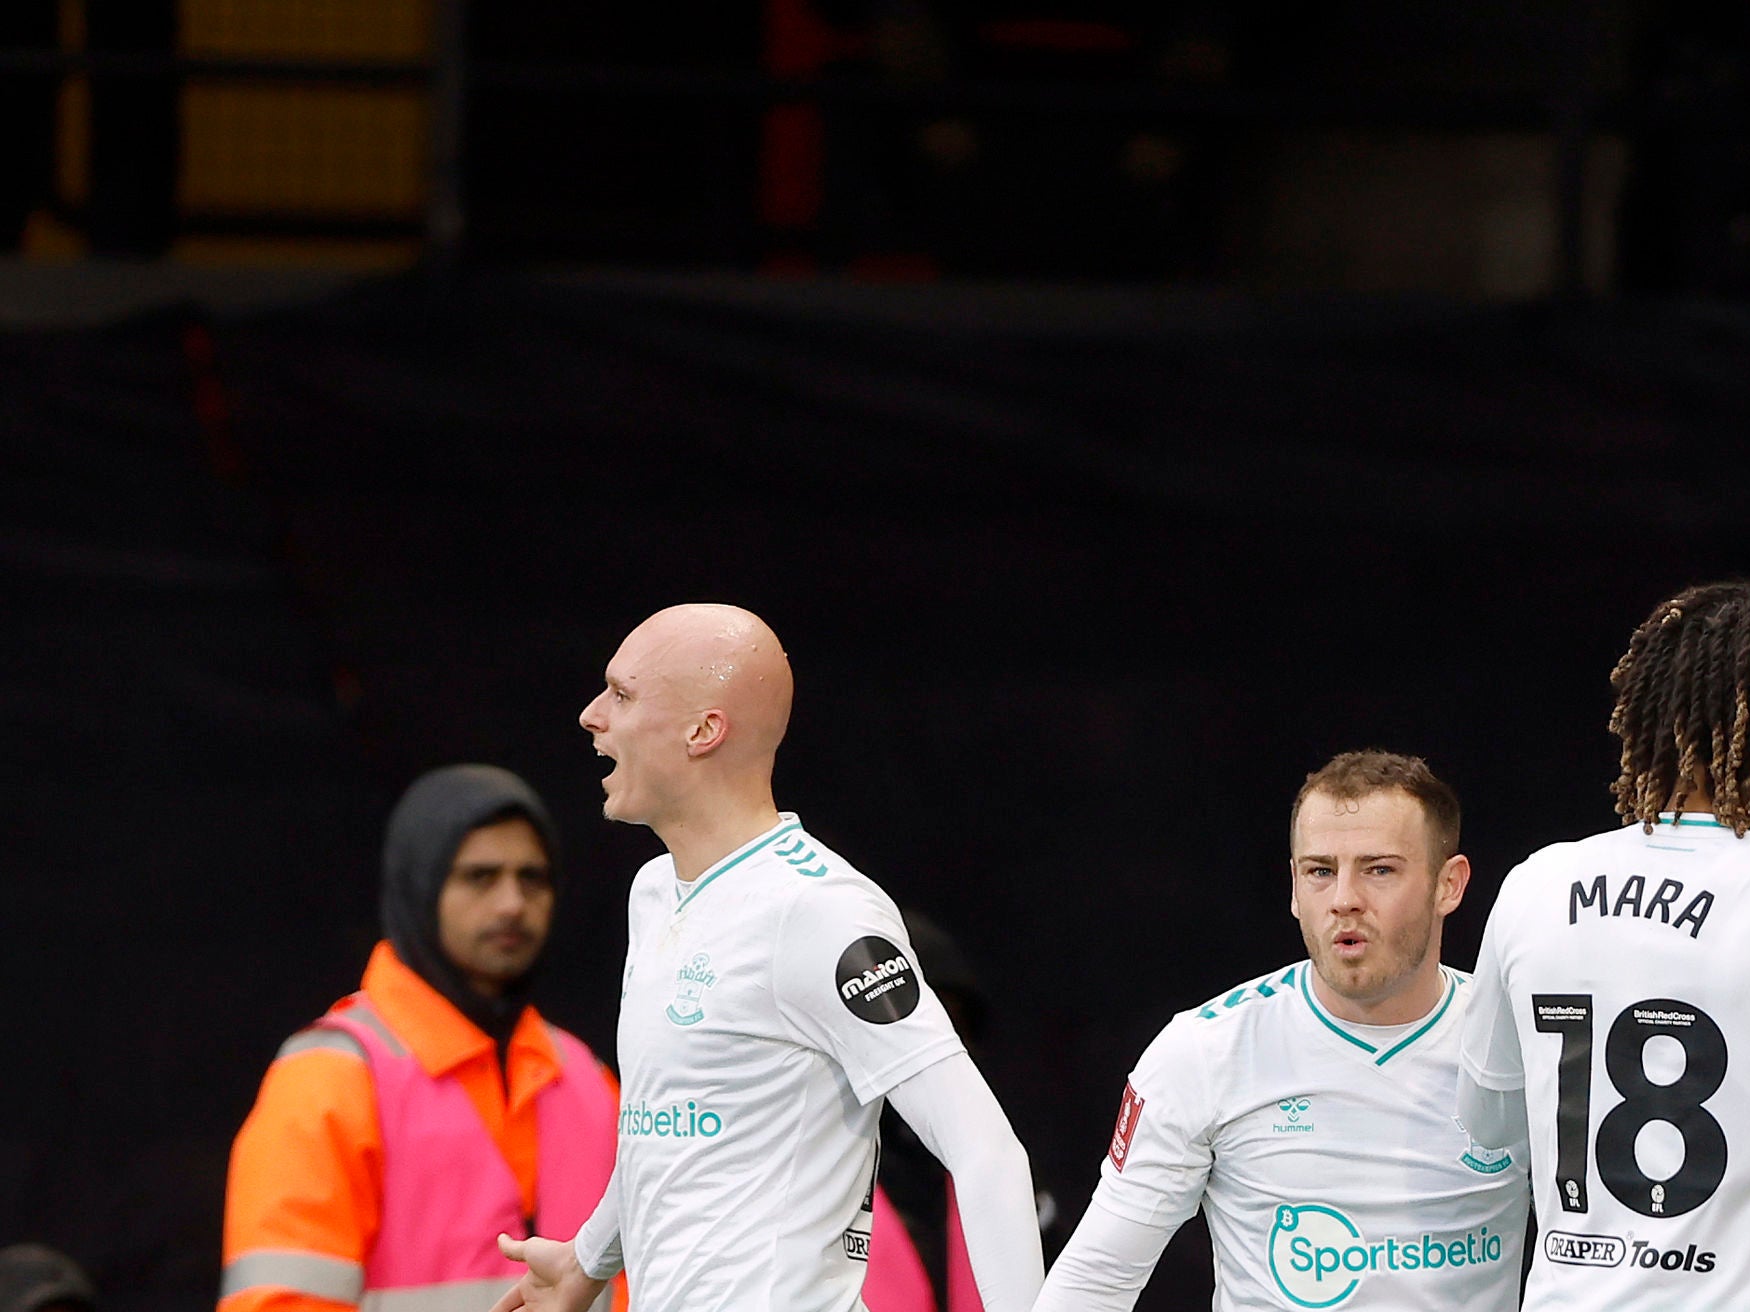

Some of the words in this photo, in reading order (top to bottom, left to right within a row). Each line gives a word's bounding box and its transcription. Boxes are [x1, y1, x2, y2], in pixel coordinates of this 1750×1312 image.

[1569, 874, 1715, 939] MARA
[618, 1099, 722, 1138] rtsbet.io
[1272, 1122, 1314, 1132] hummel
[1531, 994, 1729, 1220] 18
[1289, 1227, 1501, 1281] Sportsbet.io
[1550, 1236, 1616, 1262] DRAPER
[1630, 1240, 1717, 1273] Tools
